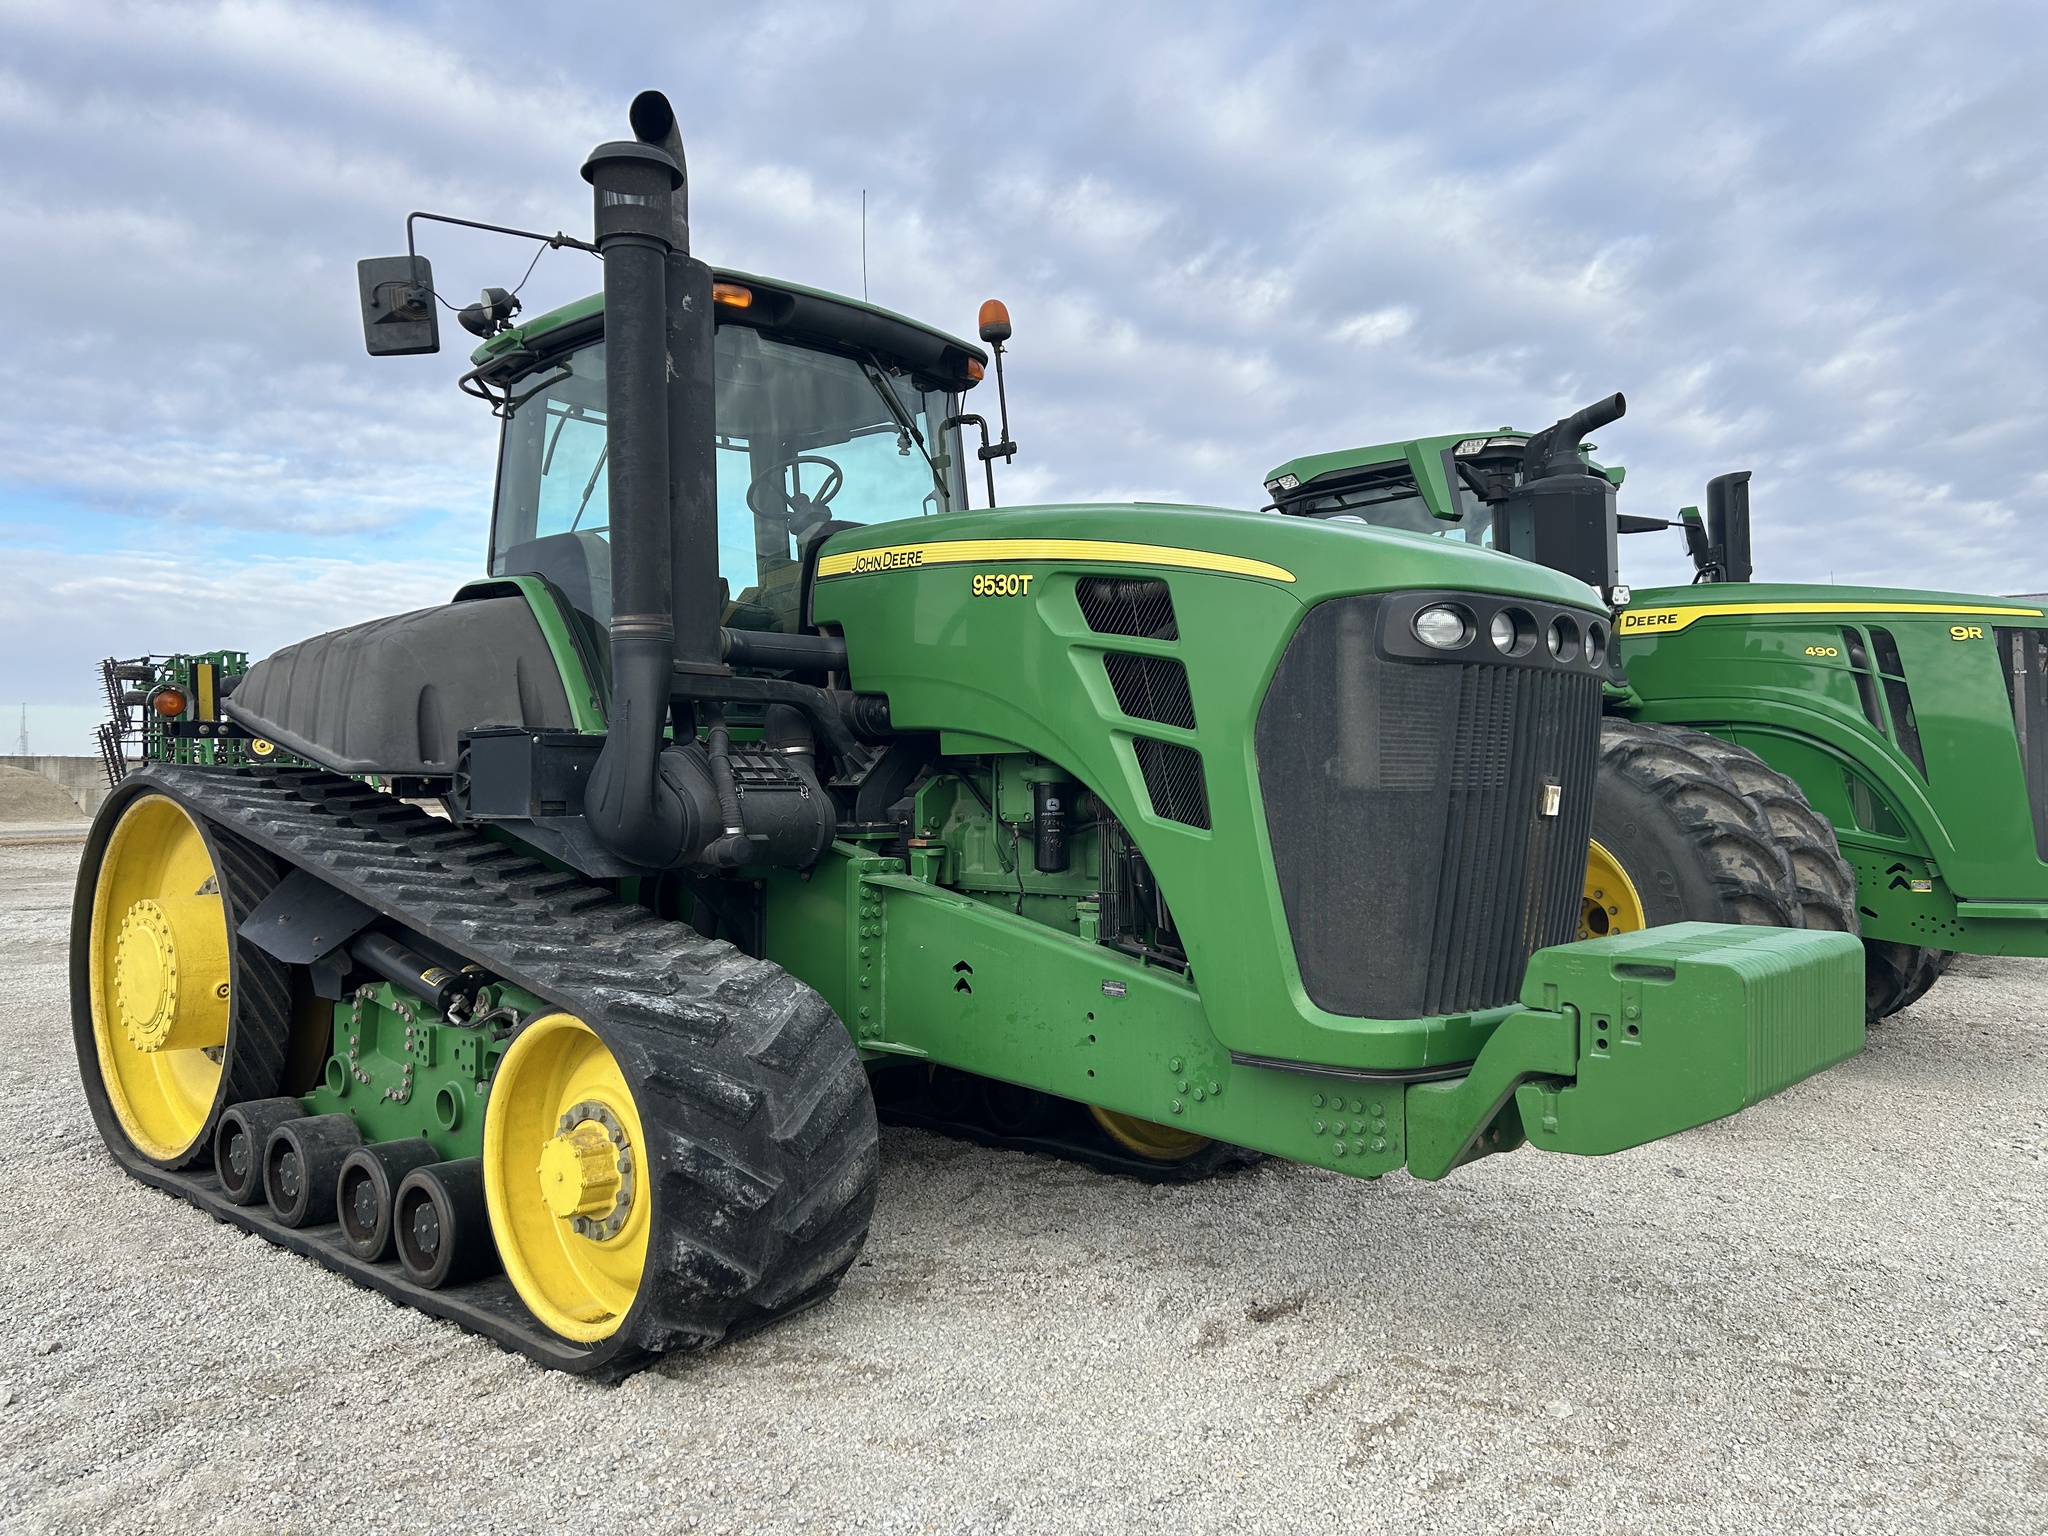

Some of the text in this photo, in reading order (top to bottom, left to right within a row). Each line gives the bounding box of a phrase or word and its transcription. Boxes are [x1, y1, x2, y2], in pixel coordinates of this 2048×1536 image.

[851, 551, 923, 572] JOHN DEERE
[972, 574, 1034, 597] 9530T
[1625, 613, 1678, 627] DEERE
[1949, 626, 1984, 641] 9R
[1804, 646, 1838, 657] 490
